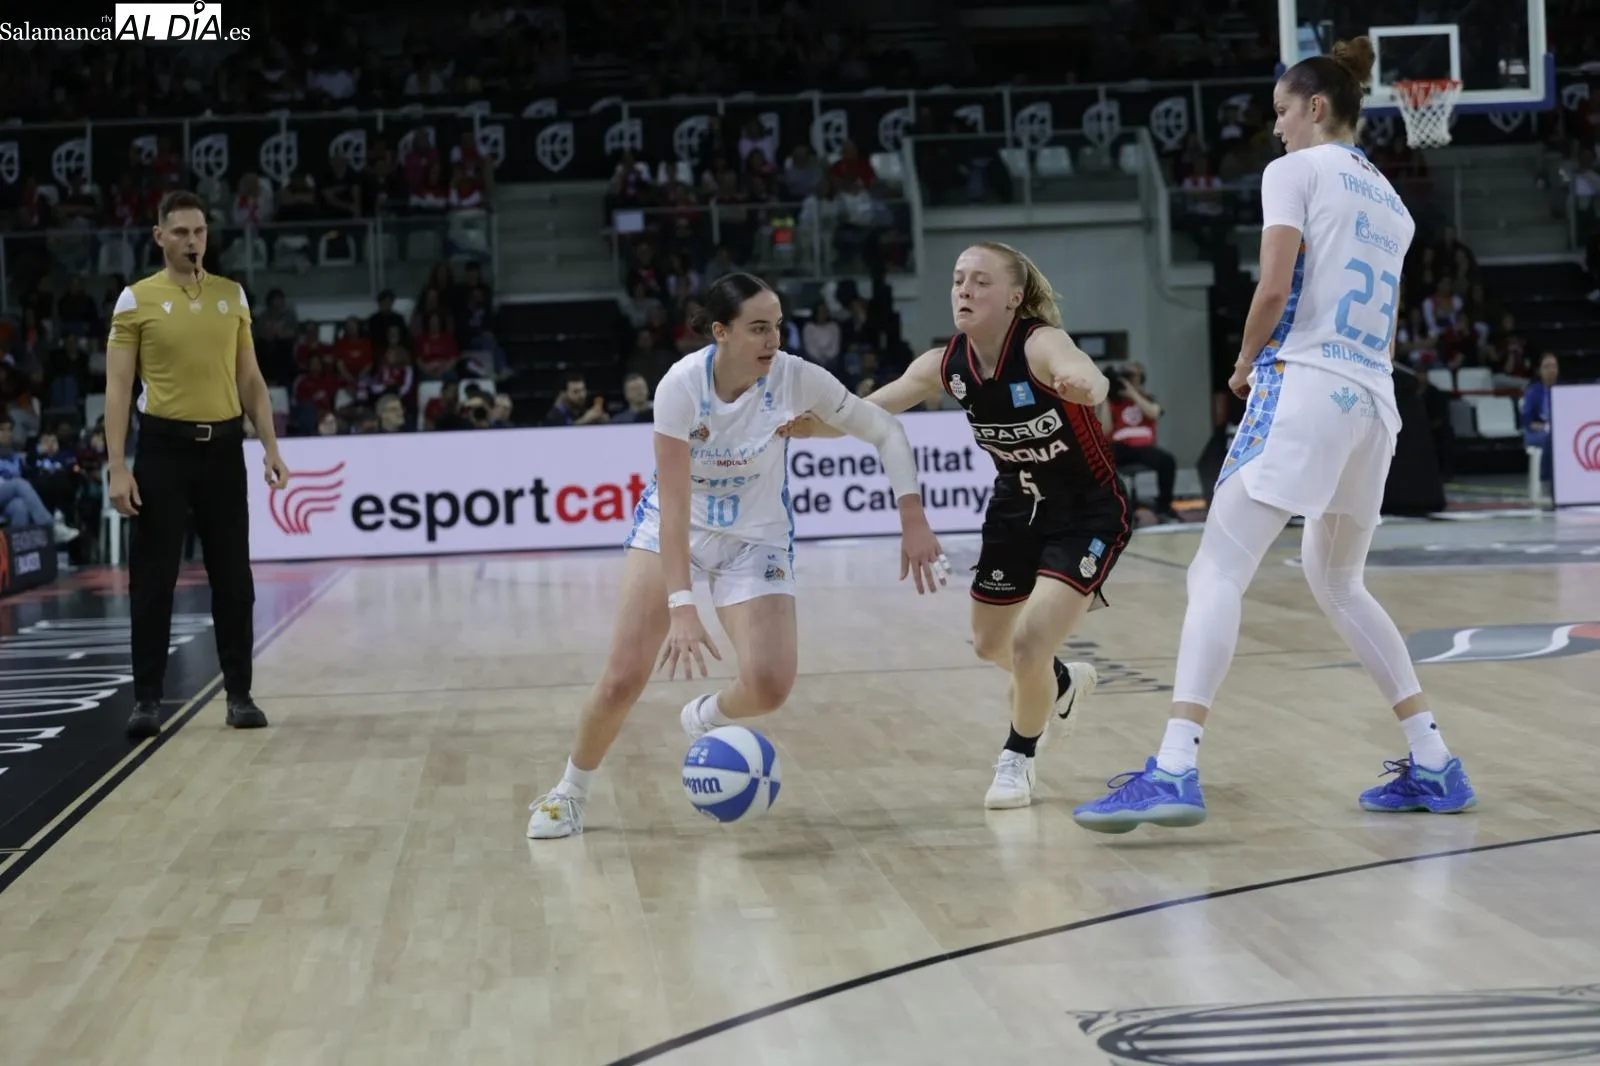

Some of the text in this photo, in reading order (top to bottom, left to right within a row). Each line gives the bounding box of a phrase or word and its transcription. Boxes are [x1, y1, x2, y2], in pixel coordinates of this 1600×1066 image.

[1335, 257, 1399, 351] 23
[790, 446, 974, 478] Genelitat
[791, 482, 993, 514] de Catluny
[1019, 469, 1040, 501] 5
[351, 473, 647, 542] esportcat
[706, 494, 741, 527] 10
